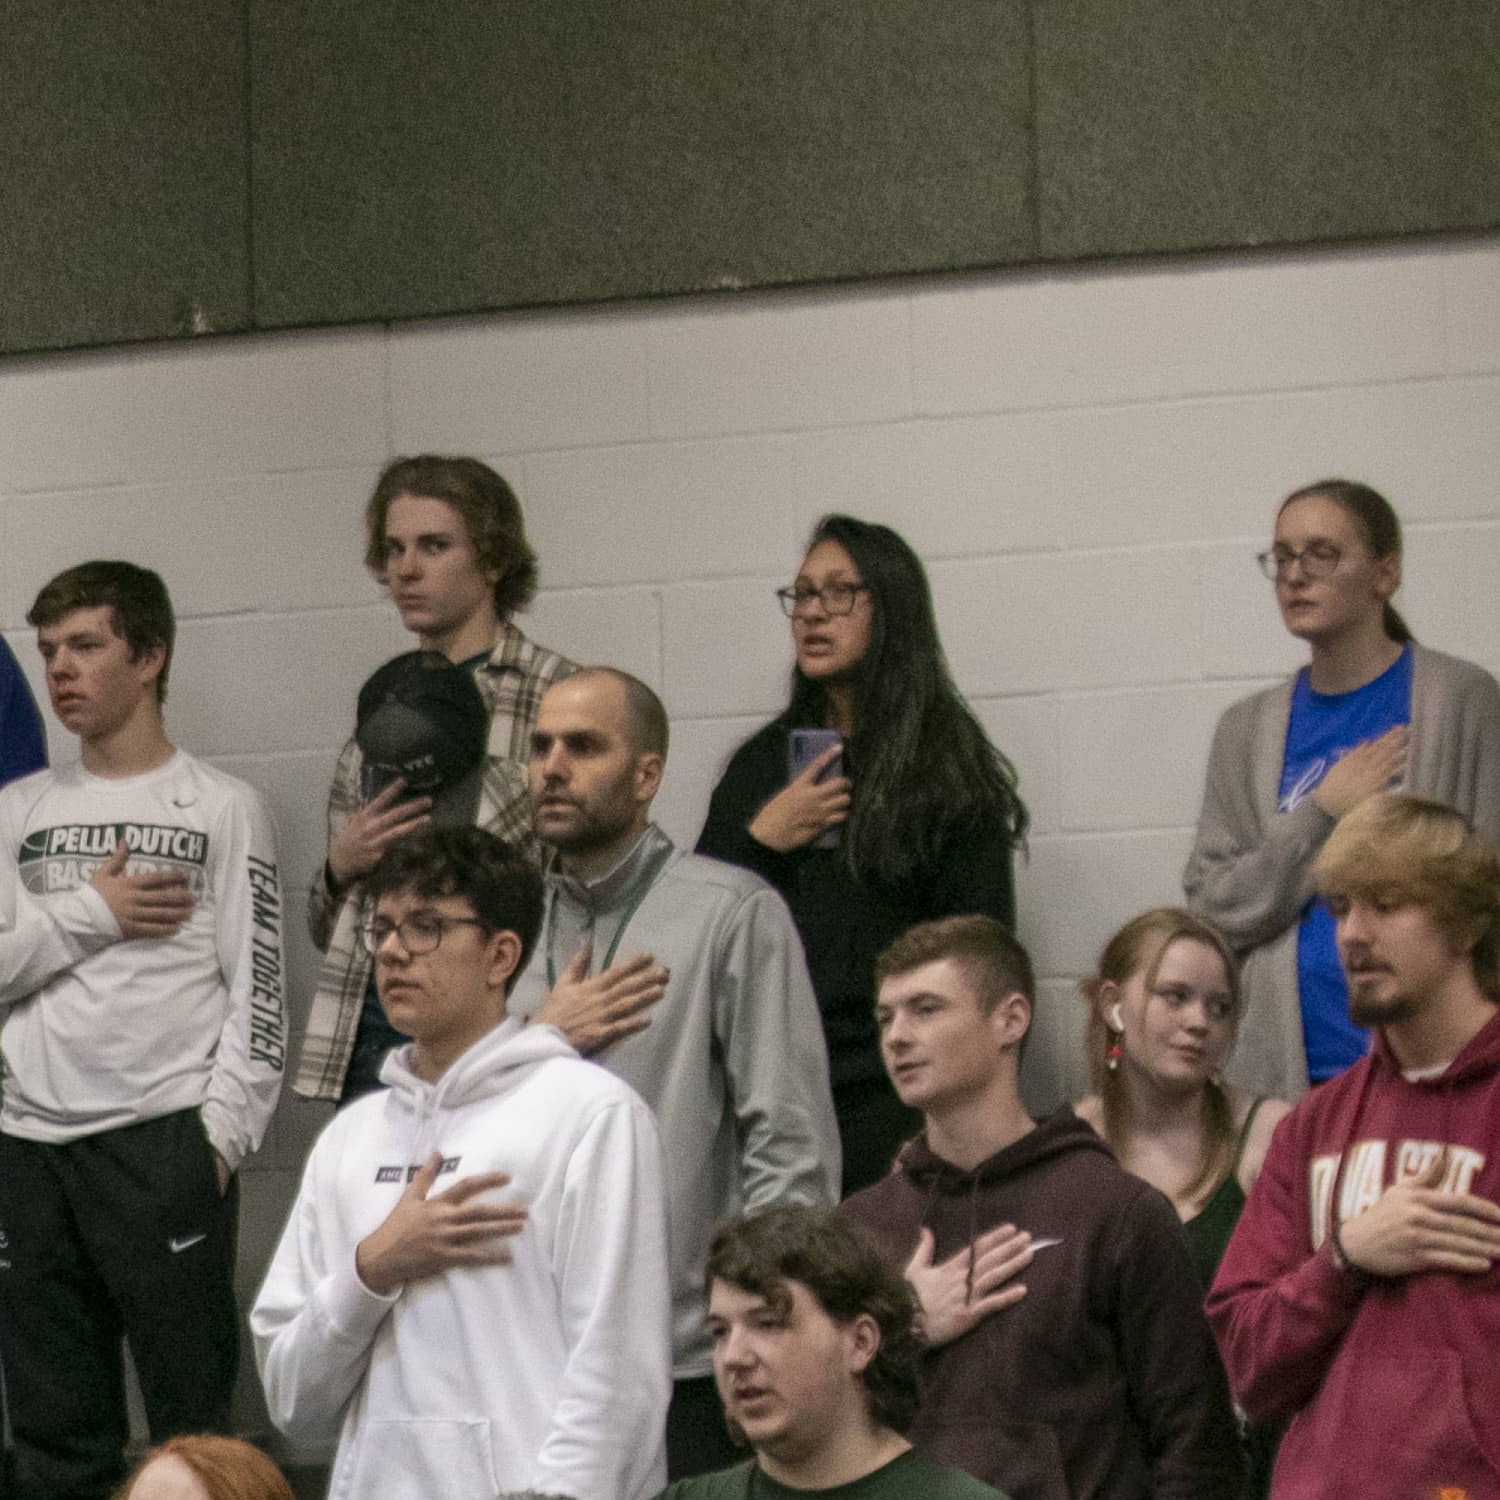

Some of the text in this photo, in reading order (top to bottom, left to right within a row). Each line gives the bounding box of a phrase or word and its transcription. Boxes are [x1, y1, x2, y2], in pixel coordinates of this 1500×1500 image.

[50, 824, 204, 861] PELLA DUTCH
[247, 855, 285, 1073] TEAM TOGETHER
